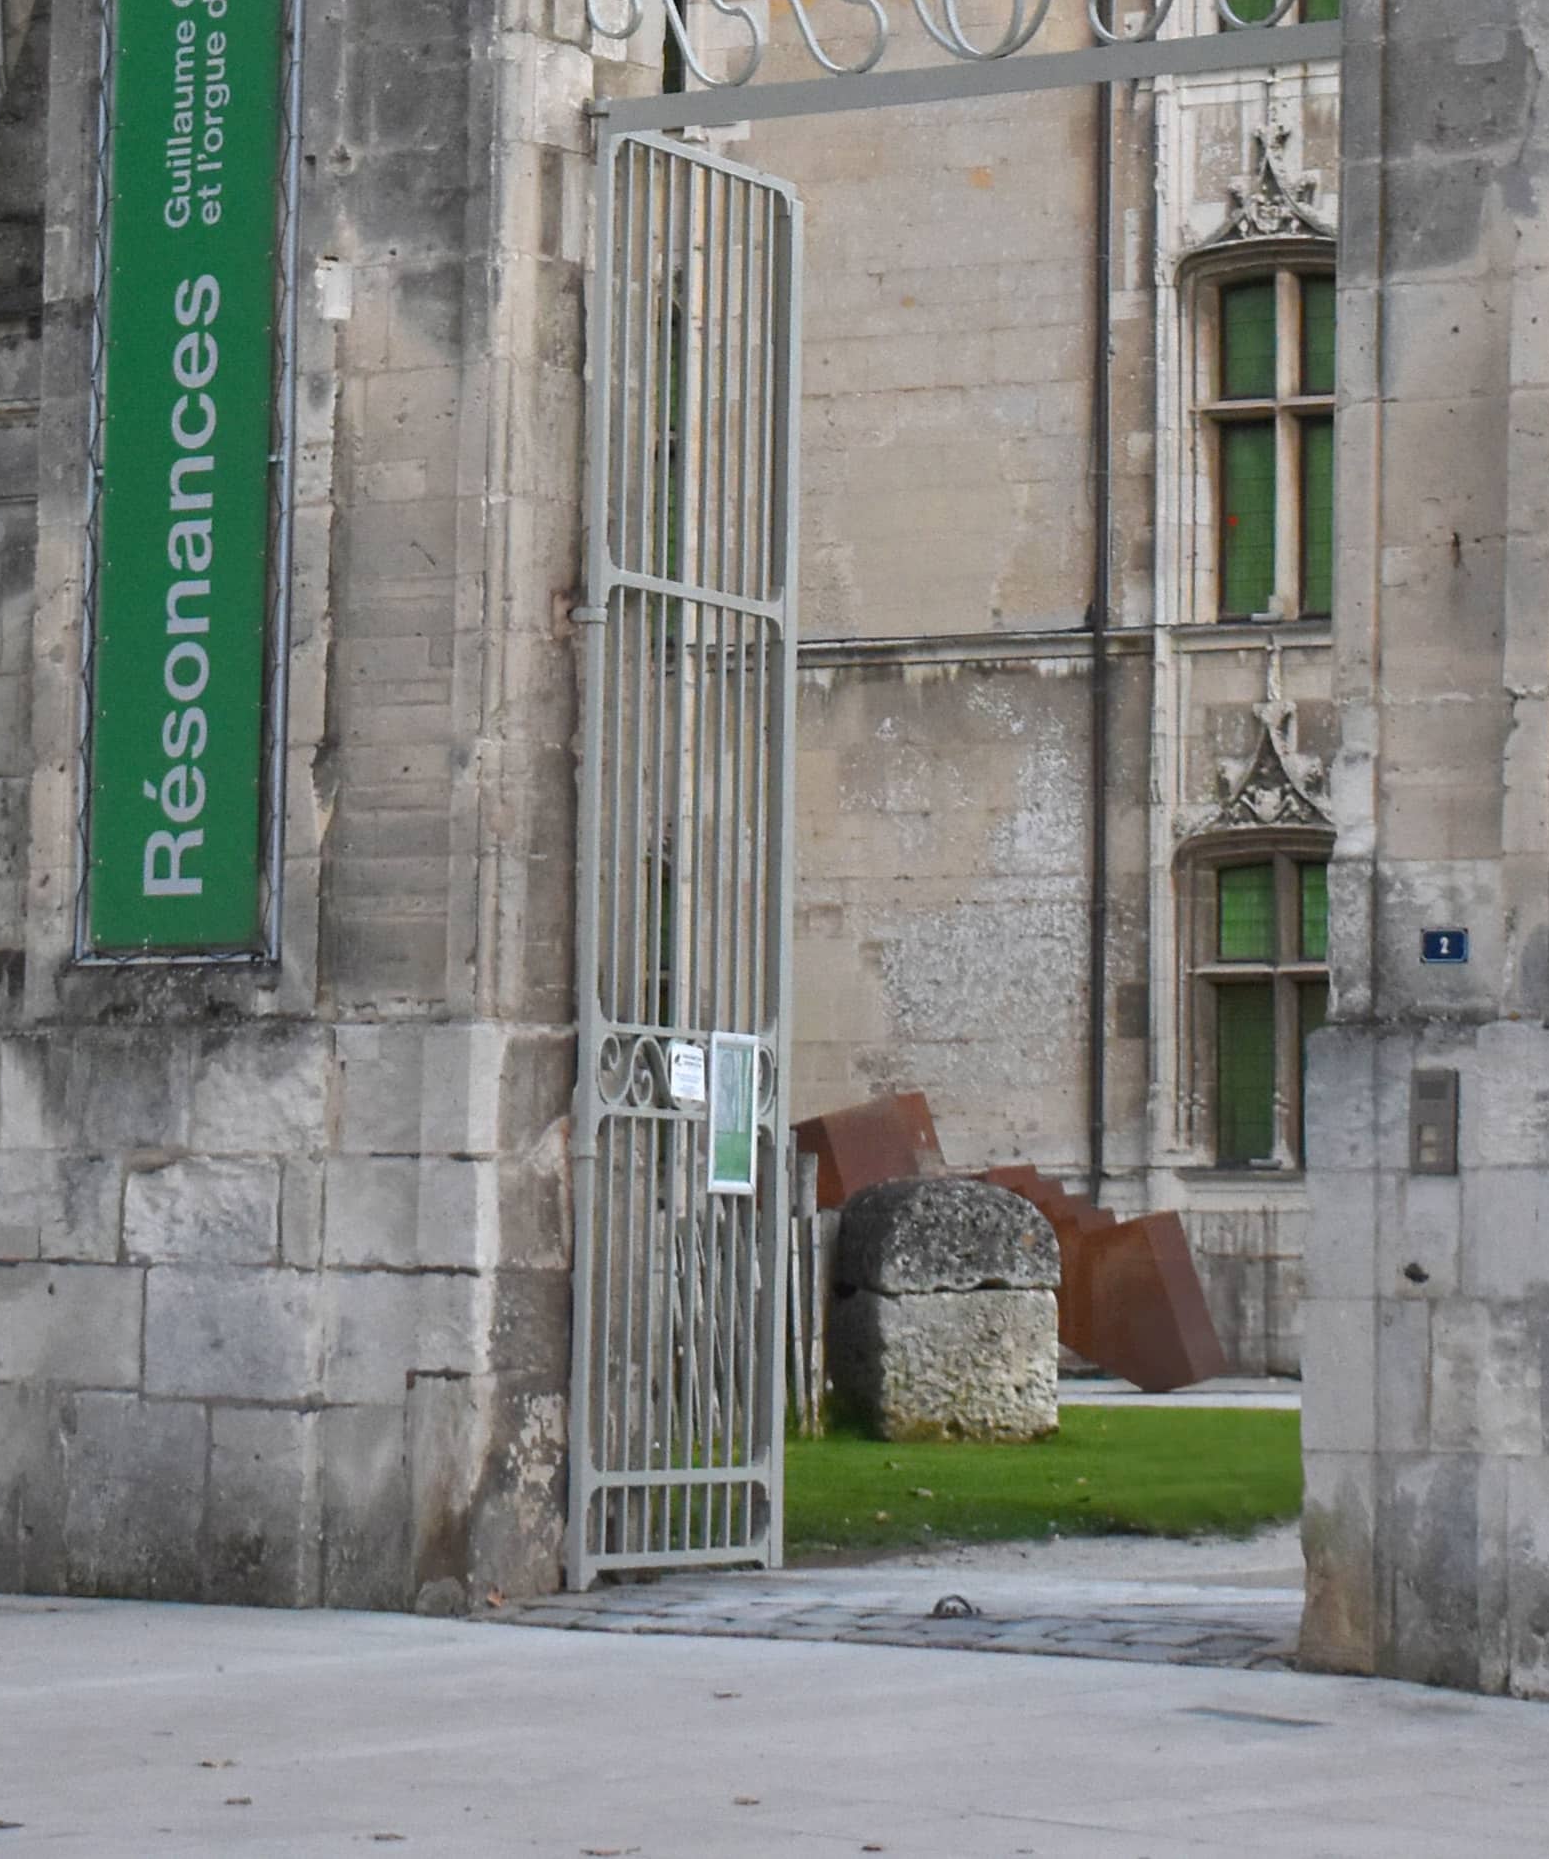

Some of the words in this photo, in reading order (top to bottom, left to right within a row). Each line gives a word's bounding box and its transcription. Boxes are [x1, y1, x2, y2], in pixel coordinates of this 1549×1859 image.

[164, 20, 196, 228] Guillaume
[198, 31, 231, 172] l'orgue
[197, 183, 222, 225] et
[142, 273, 221, 896] Résonances
